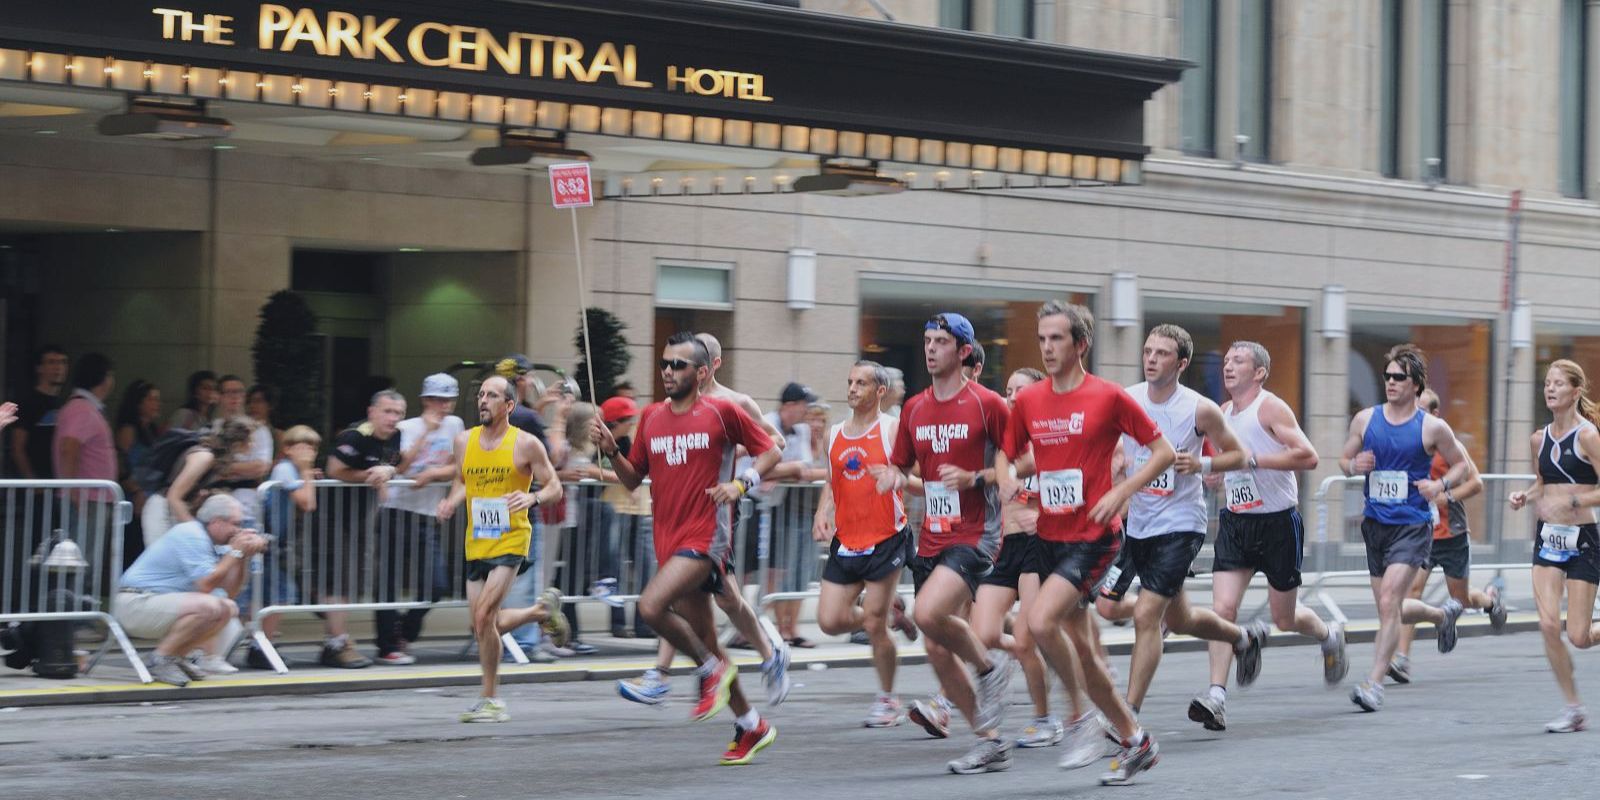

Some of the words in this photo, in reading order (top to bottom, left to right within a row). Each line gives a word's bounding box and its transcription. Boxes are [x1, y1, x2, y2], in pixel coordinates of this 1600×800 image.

[152, 7, 235, 46] THE
[258, 3, 405, 63] PARK
[406, 21, 653, 88] CENTRAL
[667, 65, 774, 102] HOTEL
[557, 177, 586, 195] 6:52
[916, 424, 937, 441] NIKE
[938, 423, 969, 441] PACER
[650, 435, 674, 455] NIKE
[675, 432, 710, 450] PACER
[931, 437, 950, 454] 6:51
[466, 467, 489, 475] FLEET
[491, 466, 511, 474] FEET
[1046, 485, 1076, 505] 1923
[1231, 485, 1254, 505] 1963
[1377, 482, 1398, 497] 749
[929, 496, 952, 515] 1975
[480, 509, 500, 525] 934
[1548, 534, 1569, 550] 991
